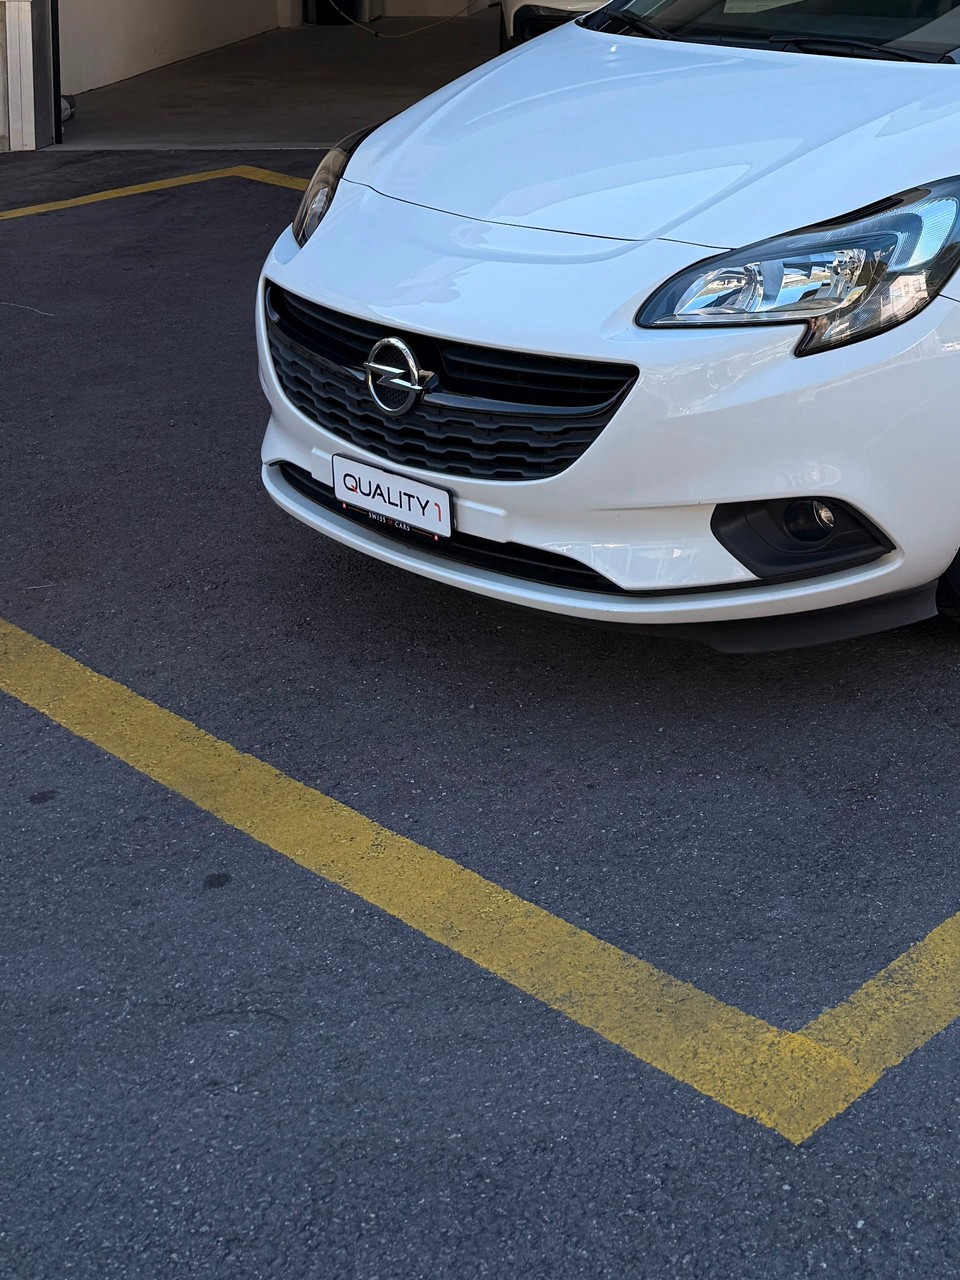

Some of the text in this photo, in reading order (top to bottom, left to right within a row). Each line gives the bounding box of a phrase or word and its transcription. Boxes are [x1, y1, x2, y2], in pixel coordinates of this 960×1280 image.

[343, 473, 430, 517] QUALITY
[368, 512, 386, 523] SWISS
[394, 521, 410, 531] CARS
